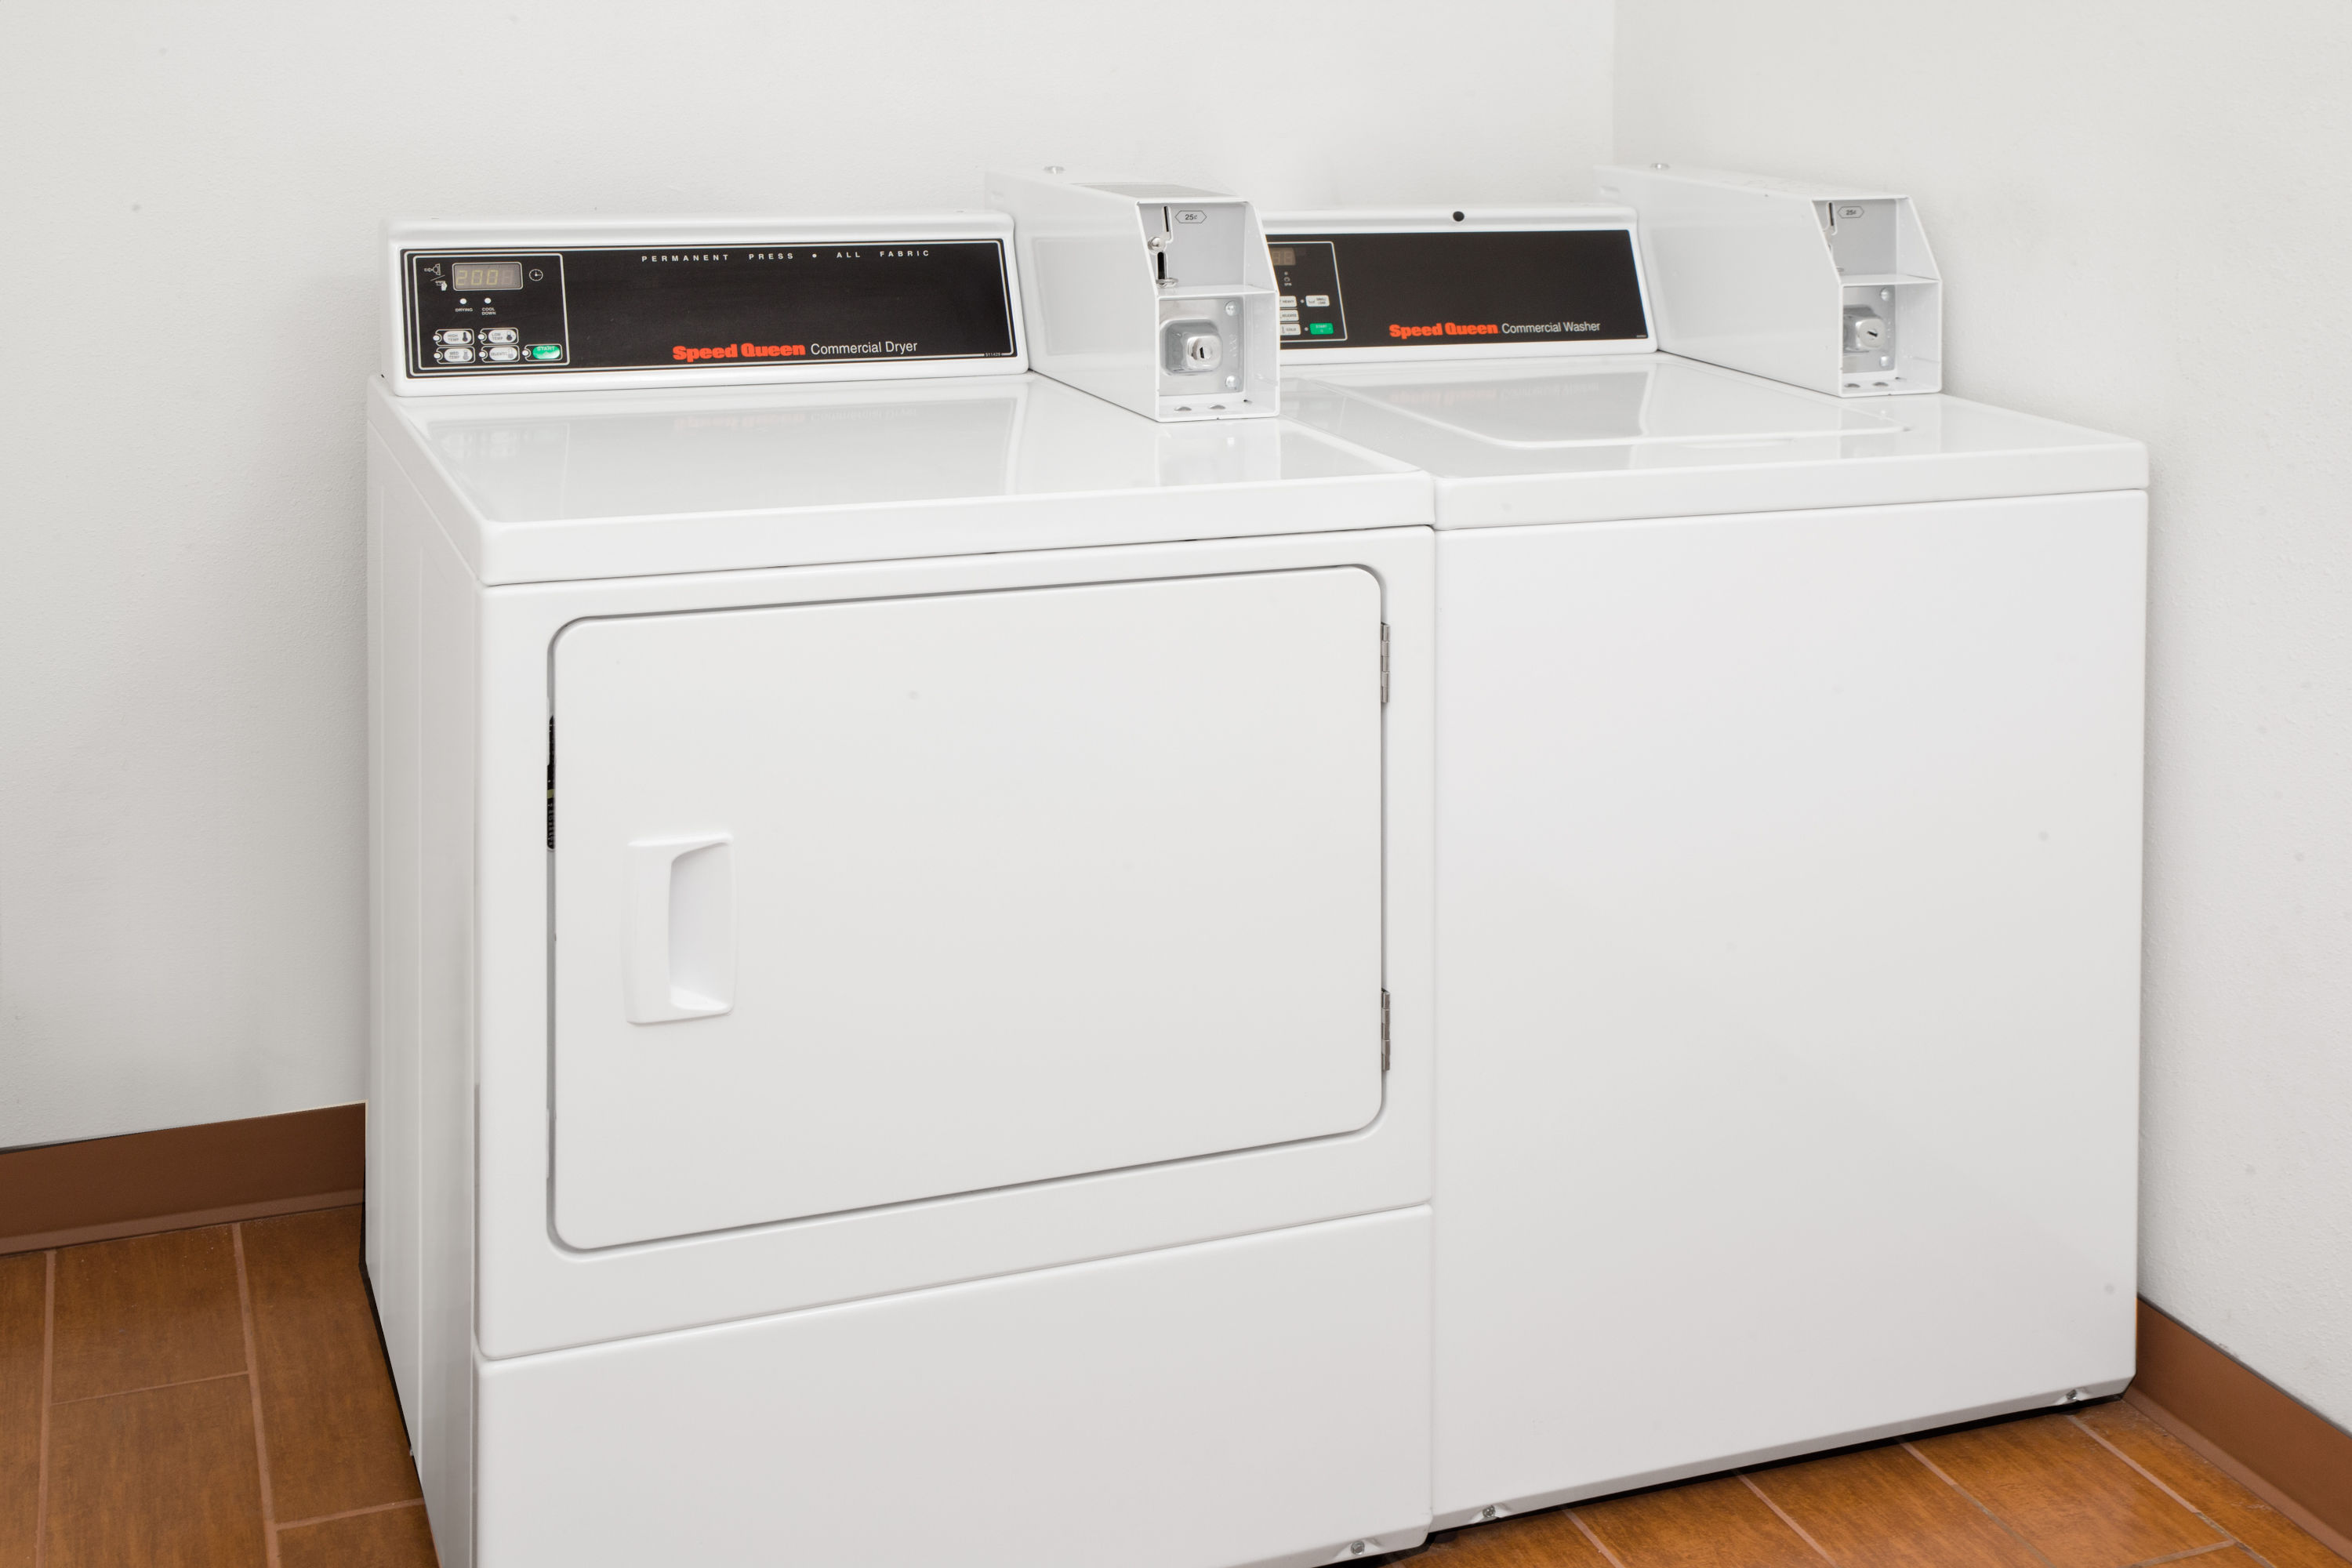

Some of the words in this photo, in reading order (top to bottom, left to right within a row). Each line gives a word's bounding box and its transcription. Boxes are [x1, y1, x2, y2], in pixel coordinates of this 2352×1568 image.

[641, 254, 729, 263] PERMANENT
[456, 270, 498, 285] 200
[1388, 323, 1443, 339] Speed
[1444, 322, 1499, 336] Queen
[1501, 321, 1561, 334] Commercial
[1563, 321, 1601, 332] Washer
[673, 343, 739, 363] Speed
[740, 342, 806, 358] Queen
[811, 341, 882, 355] Commercial
[885, 340, 918, 355] Dryer
